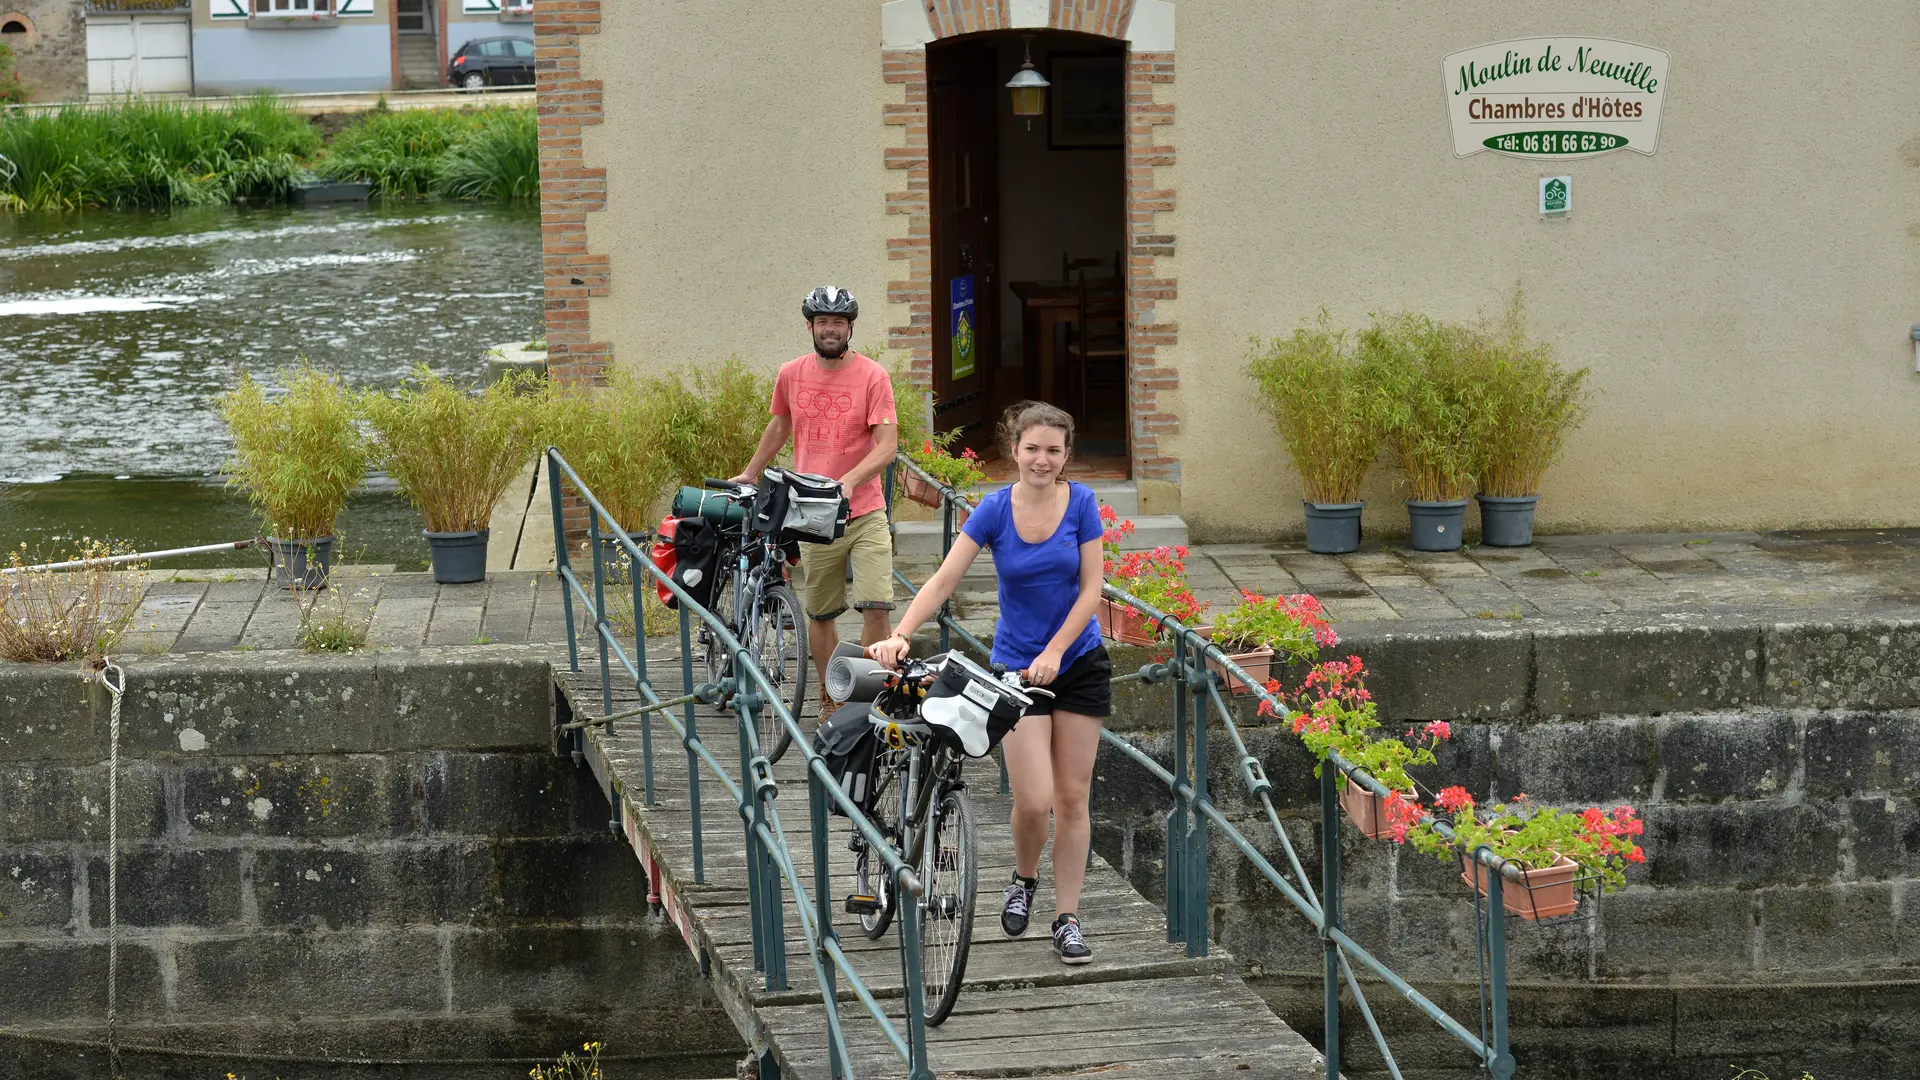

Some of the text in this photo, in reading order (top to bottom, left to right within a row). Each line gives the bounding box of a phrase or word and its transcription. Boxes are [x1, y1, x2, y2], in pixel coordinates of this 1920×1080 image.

[1455, 45, 1658, 95] Moulin de Neuville
[1468, 96, 1643, 119] Chambres d'Hôtes
[1497, 134, 1616, 152] Tél: 06 81 66 62 90
